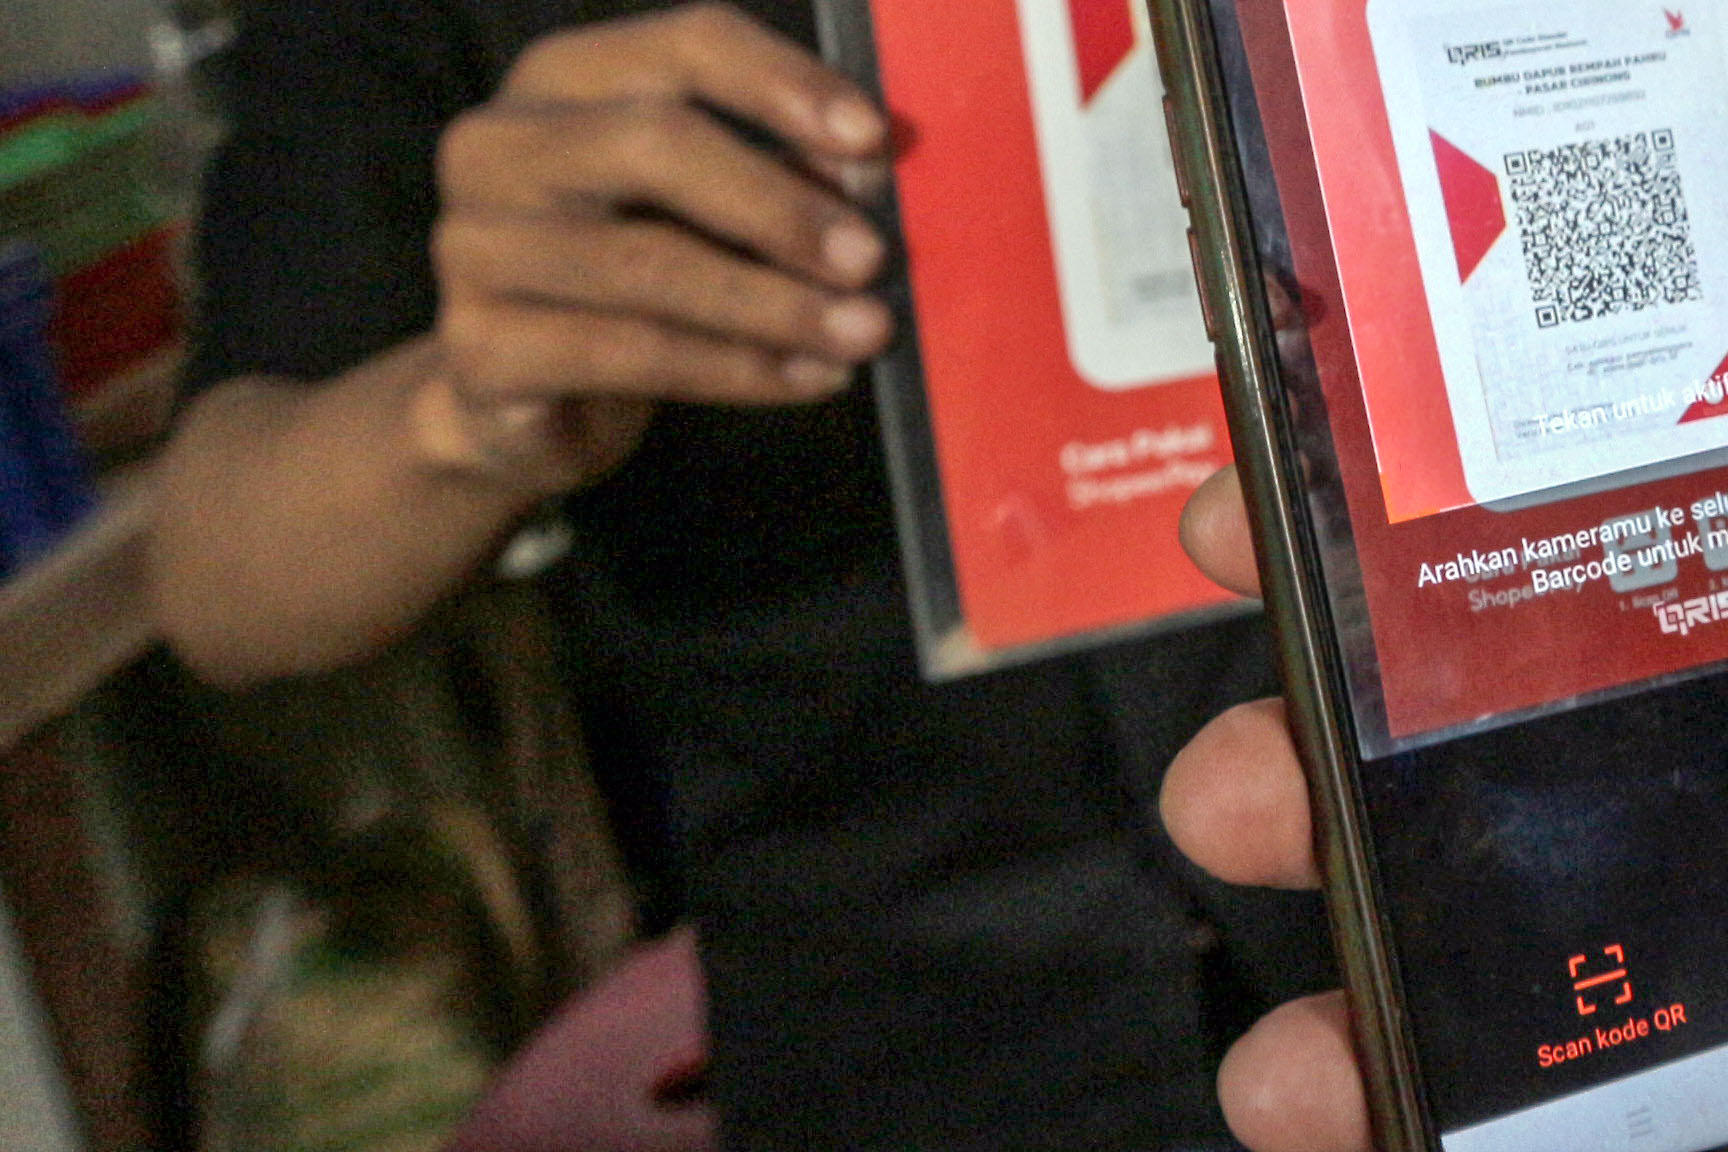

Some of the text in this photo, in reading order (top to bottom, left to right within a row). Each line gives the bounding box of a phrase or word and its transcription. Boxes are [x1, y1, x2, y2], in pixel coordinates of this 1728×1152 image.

[1523, 66, 1567, 82] DAPUR
[1535, 402, 1608, 438] Tekan
[1612, 388, 1676, 421] untuk
[1417, 543, 1519, 589] Arahkan
[1522, 513, 1653, 564] kameramu
[1655, 504, 1686, 532] ke
[1531, 555, 1633, 596] Barcode
[1636, 534, 1704, 571] untuk
[1537, 1002, 1687, 1068] Scan kode QR
